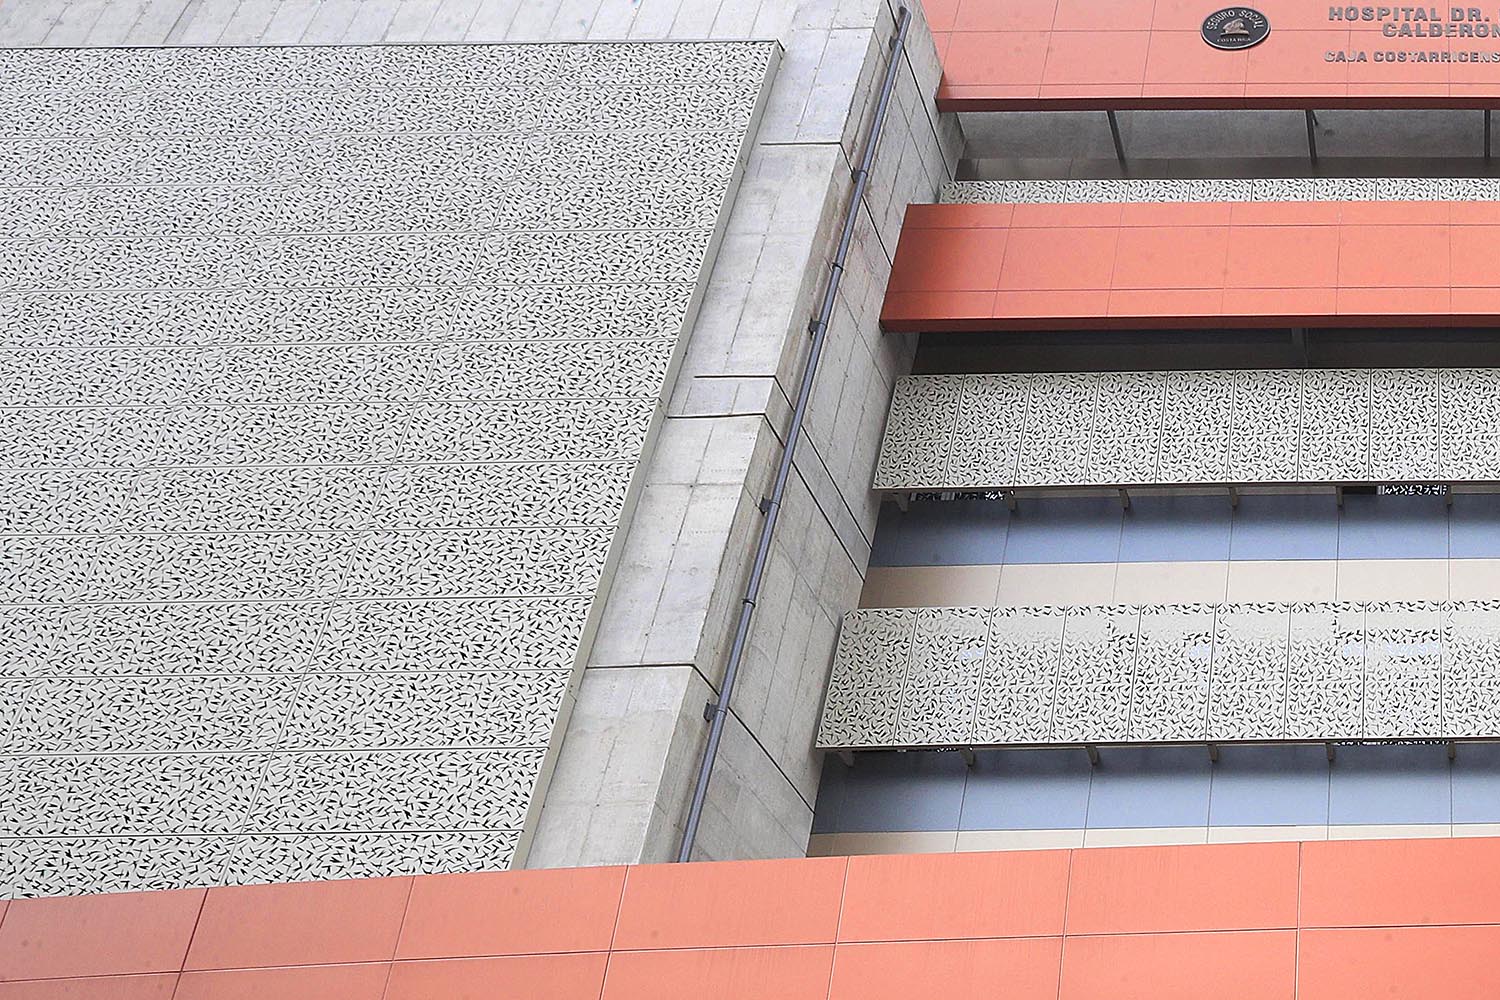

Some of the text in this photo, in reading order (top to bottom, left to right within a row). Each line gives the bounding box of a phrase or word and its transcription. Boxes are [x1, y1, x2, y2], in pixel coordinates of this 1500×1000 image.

[1206, 10, 1264, 29] SEGURO SOCIAL
[1328, 7, 1441, 22] HOSPITAL
[1451, 7, 1490, 22] DR.
[1324, 51, 1367, 63] CAJA
